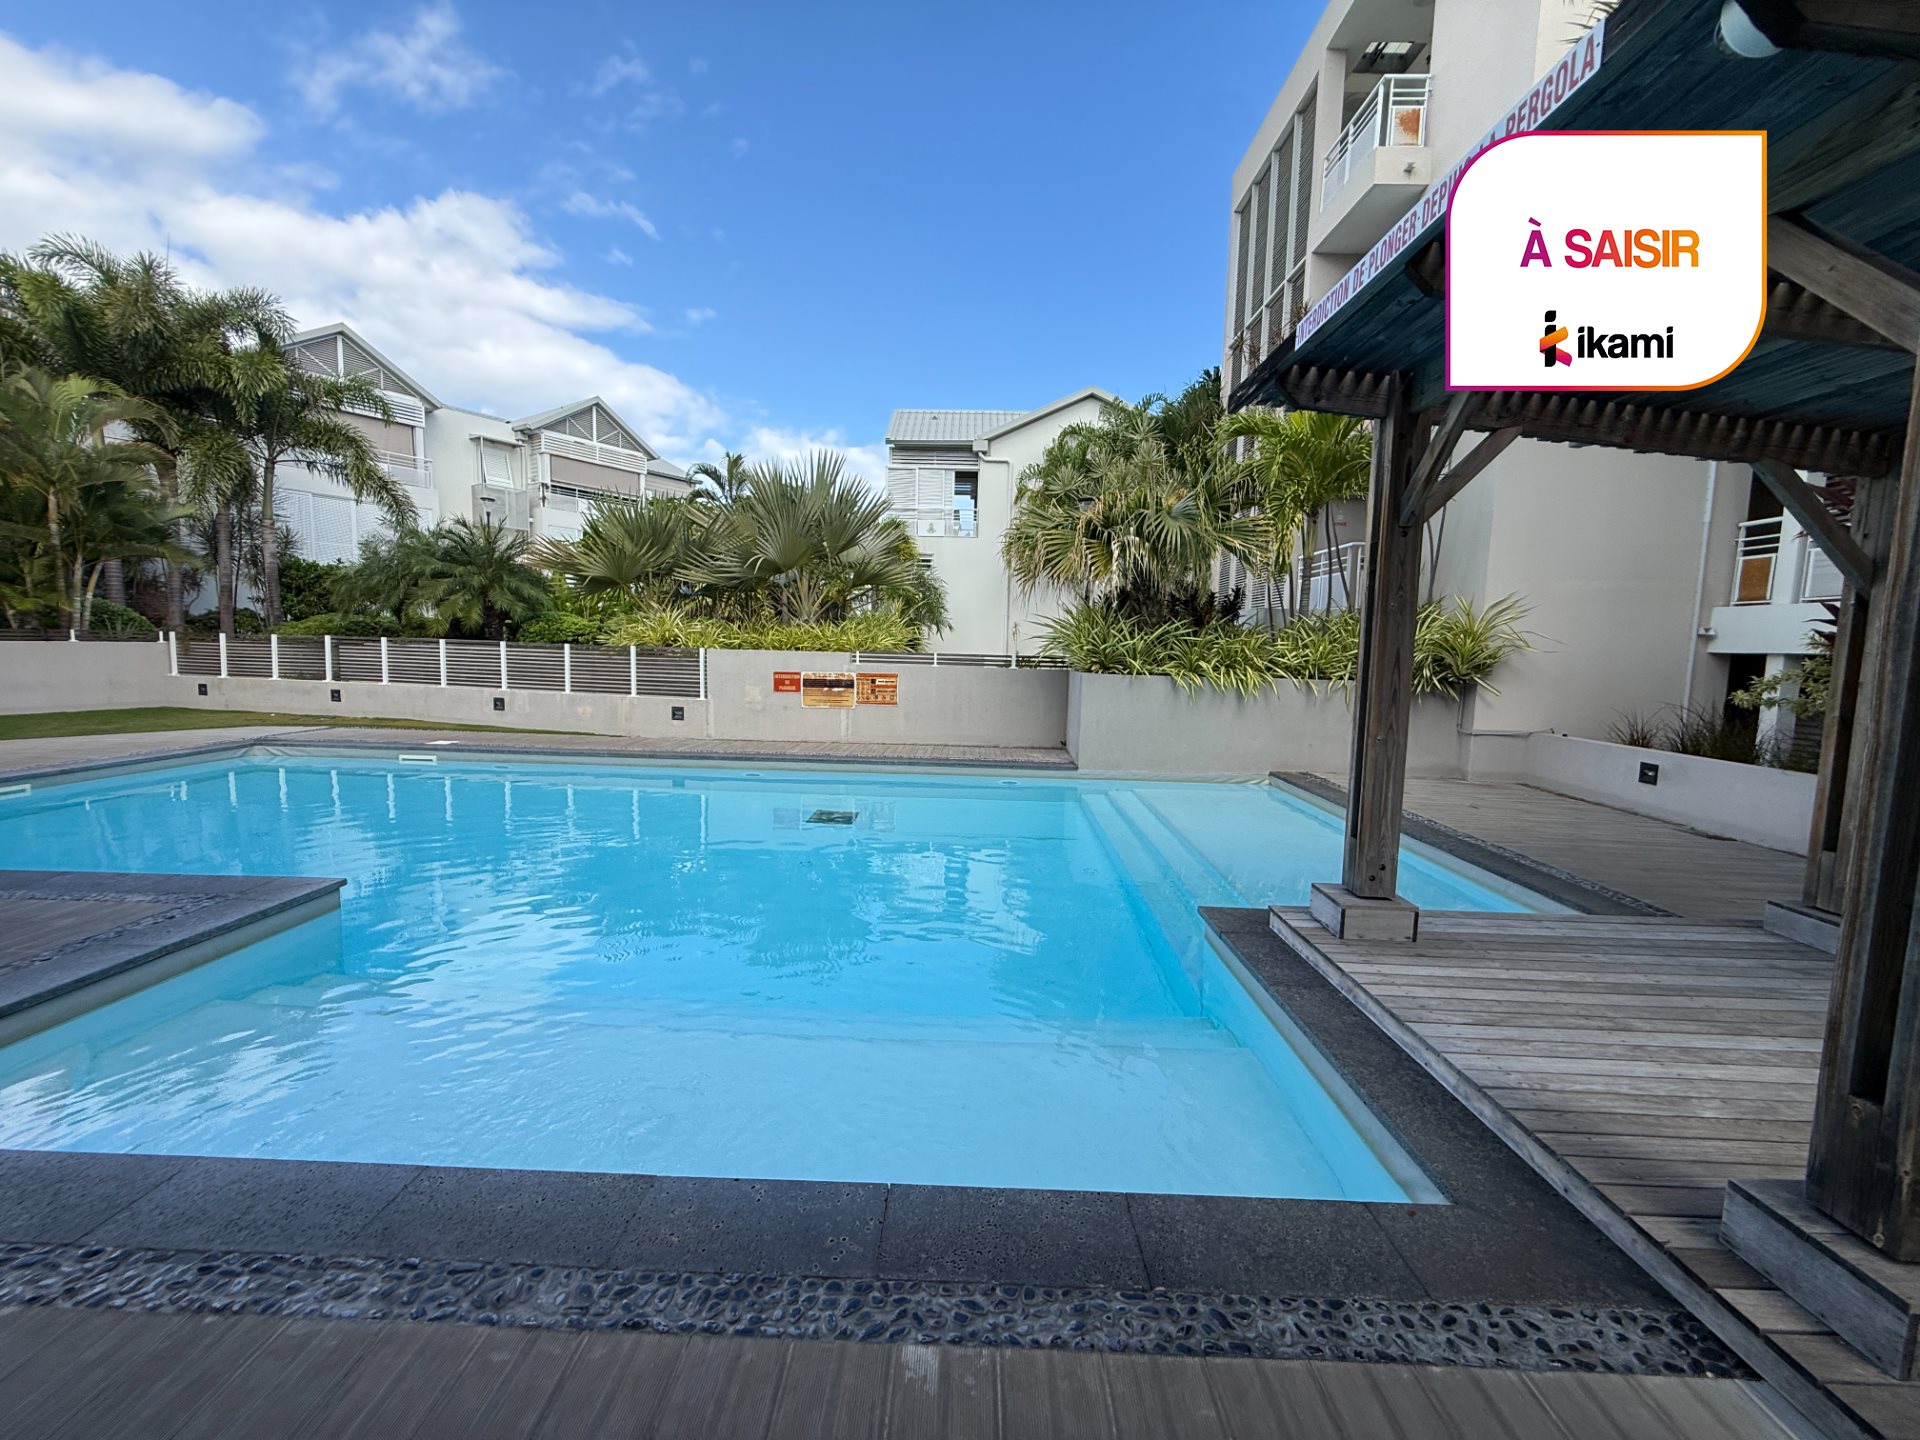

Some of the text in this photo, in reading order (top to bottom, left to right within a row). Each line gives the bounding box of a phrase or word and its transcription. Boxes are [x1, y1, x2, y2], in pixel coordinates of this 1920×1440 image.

[1297, 276, 1350, 345] INTERDICTION
[1353, 260, 1365, 294] DE
[1368, 209, 1417, 279] PLONGER
[1505, 33, 1595, 136] PERGOLA
